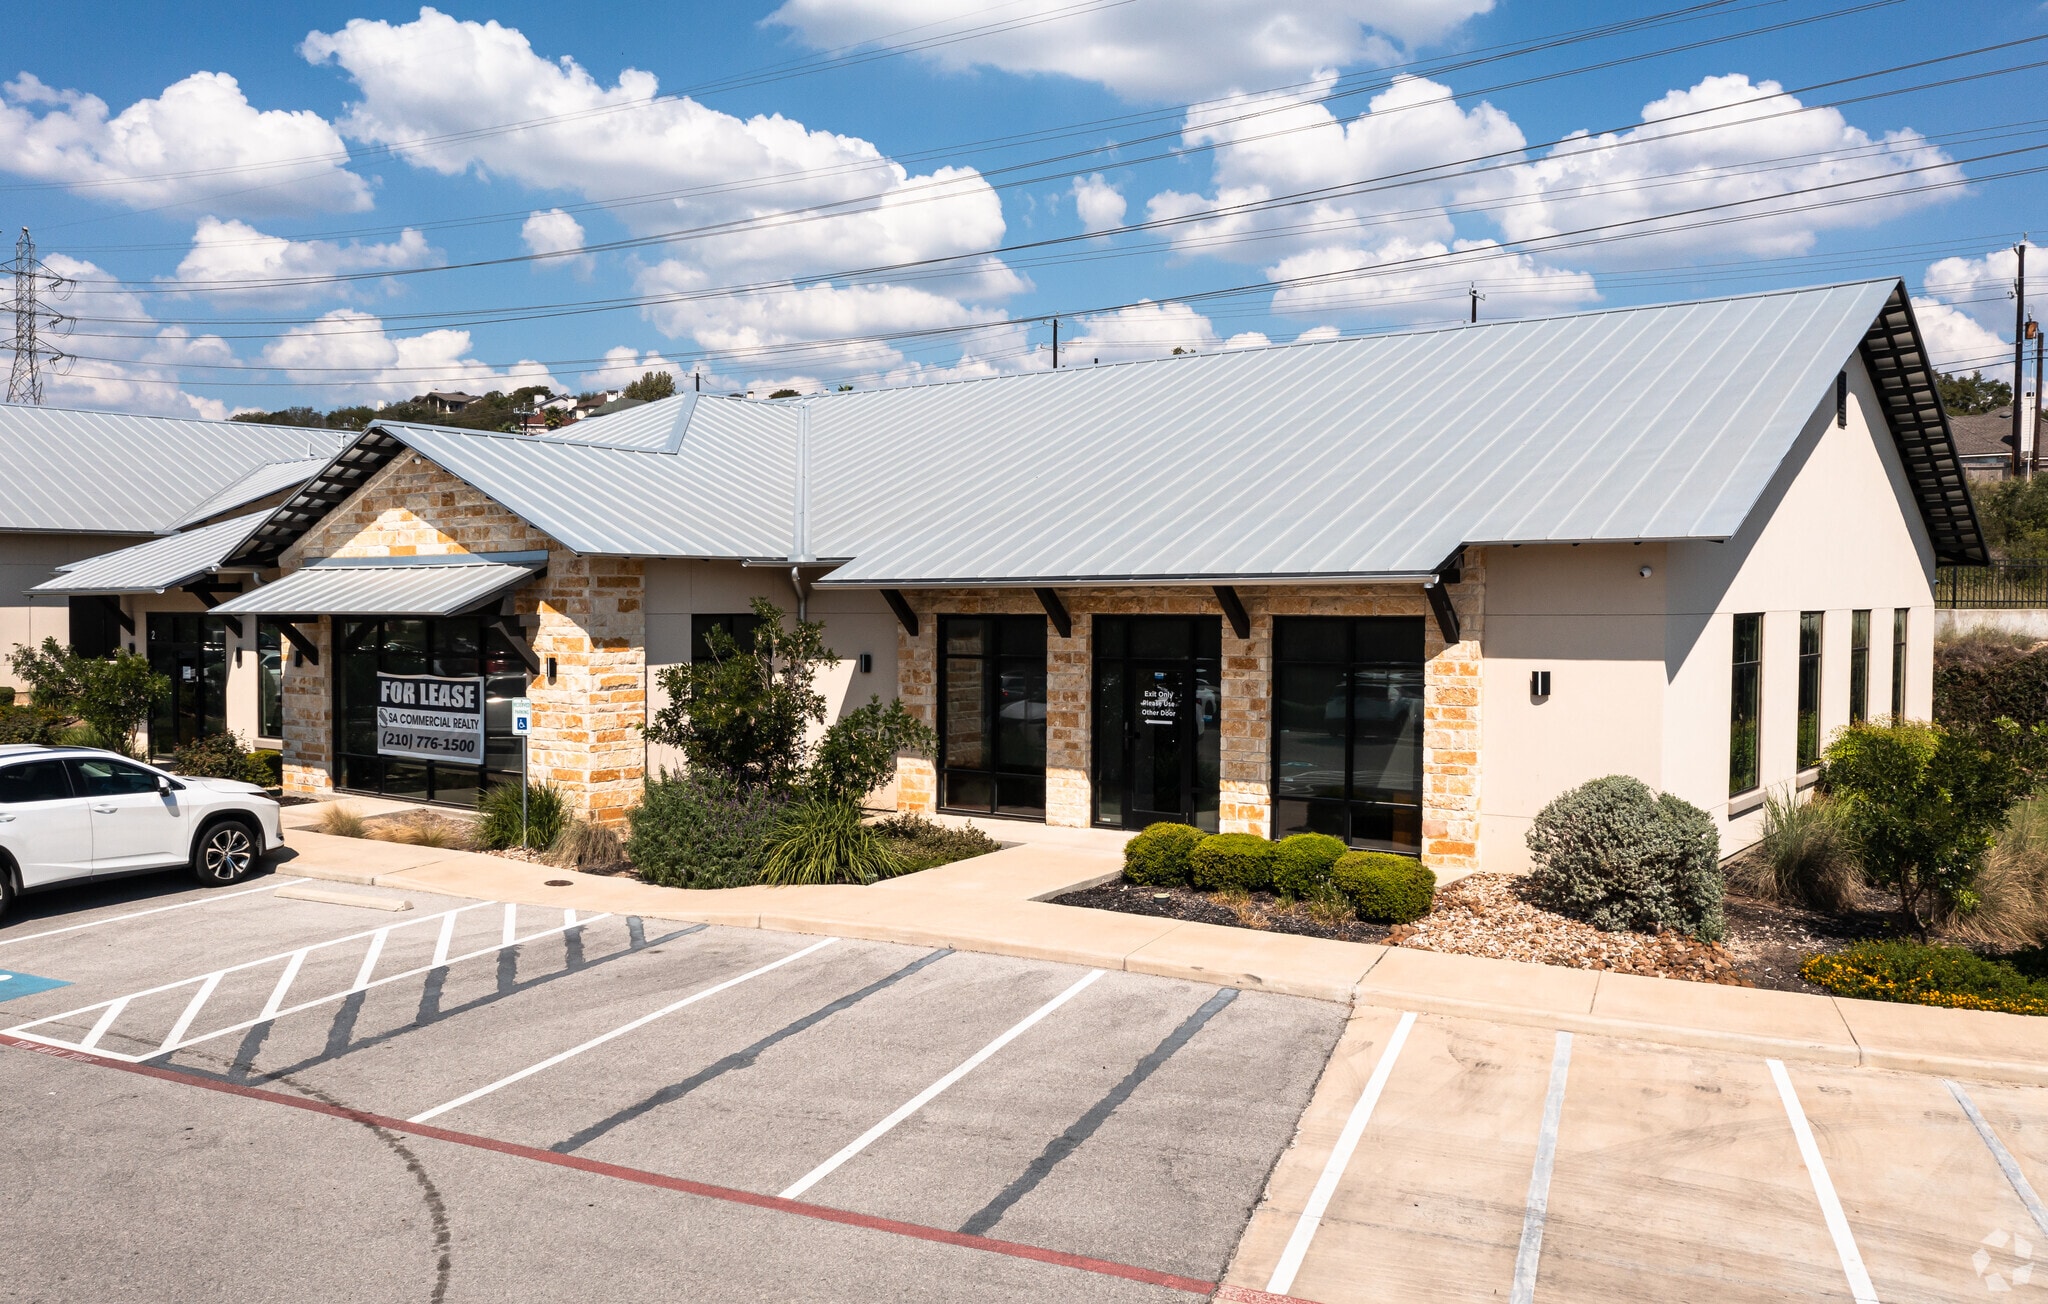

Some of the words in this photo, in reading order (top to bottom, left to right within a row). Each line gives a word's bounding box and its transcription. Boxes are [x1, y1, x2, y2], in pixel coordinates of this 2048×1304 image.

[381, 680, 416, 705] FOR
[419, 683, 475, 708] LEASE
[1142, 699, 1162, 707] Please
[1158, 691, 1174, 699] Only
[388, 712, 398, 723] SA
[399, 713, 451, 728] COMMERCIAL
[453, 718, 479, 730] REALTY
[382, 731, 413, 749] (210)
[416, 735, 475, 753] 776-1500
